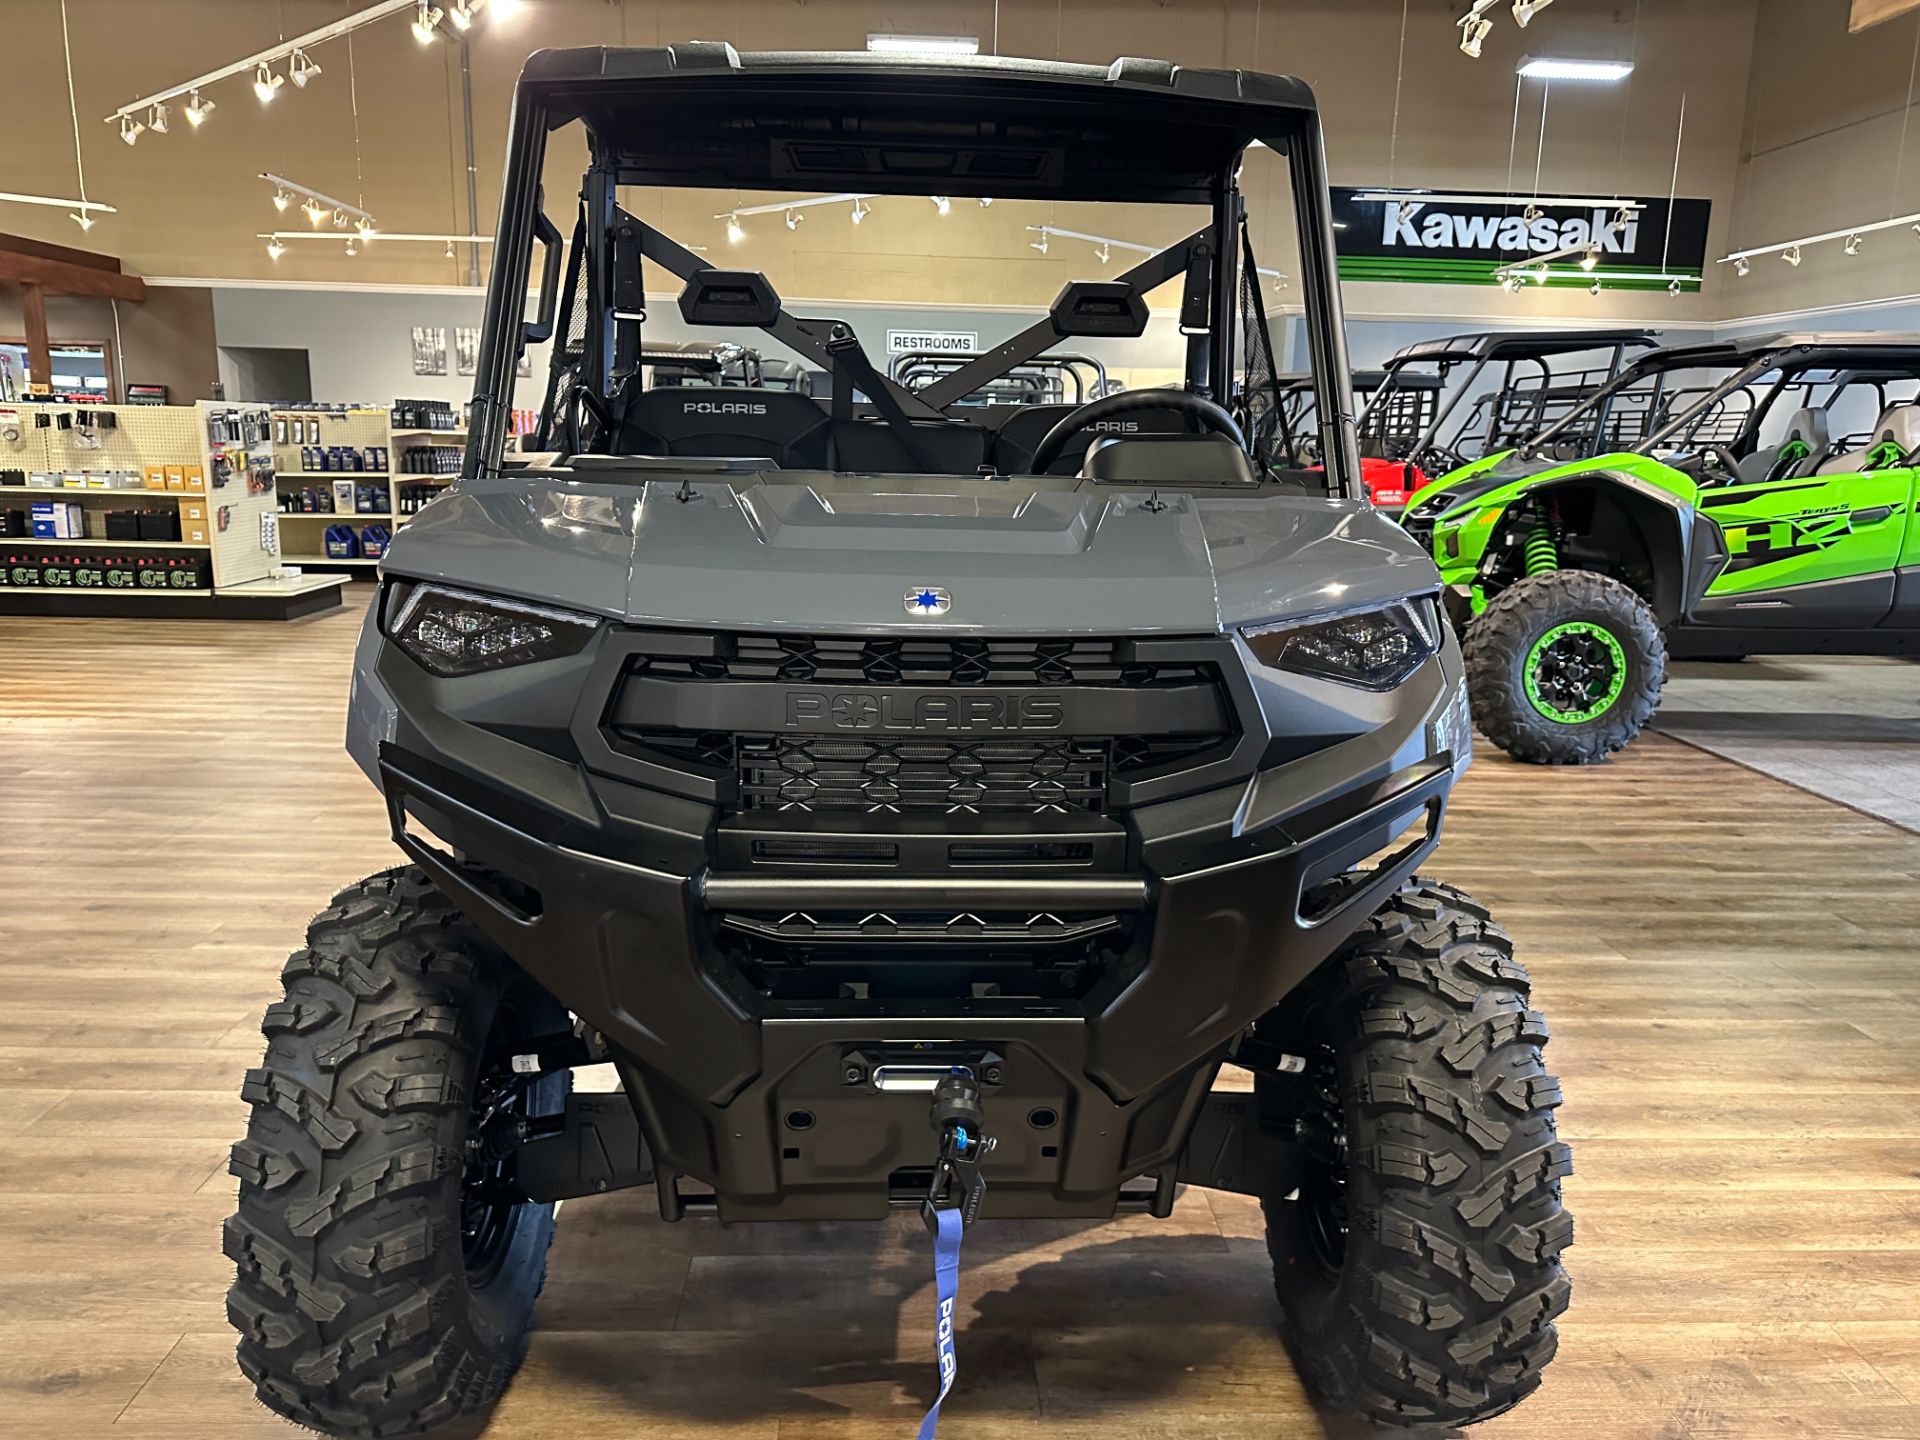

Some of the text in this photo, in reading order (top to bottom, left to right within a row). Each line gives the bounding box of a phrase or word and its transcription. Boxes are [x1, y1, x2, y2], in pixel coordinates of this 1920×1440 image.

[1382, 201, 1640, 254] Kawasaki
[894, 336, 971, 350] RESTROOMS
[683, 402, 767, 415] POLARIS
[1080, 421, 1139, 432] LARIS
[786, 691, 1065, 730] POLARIS
